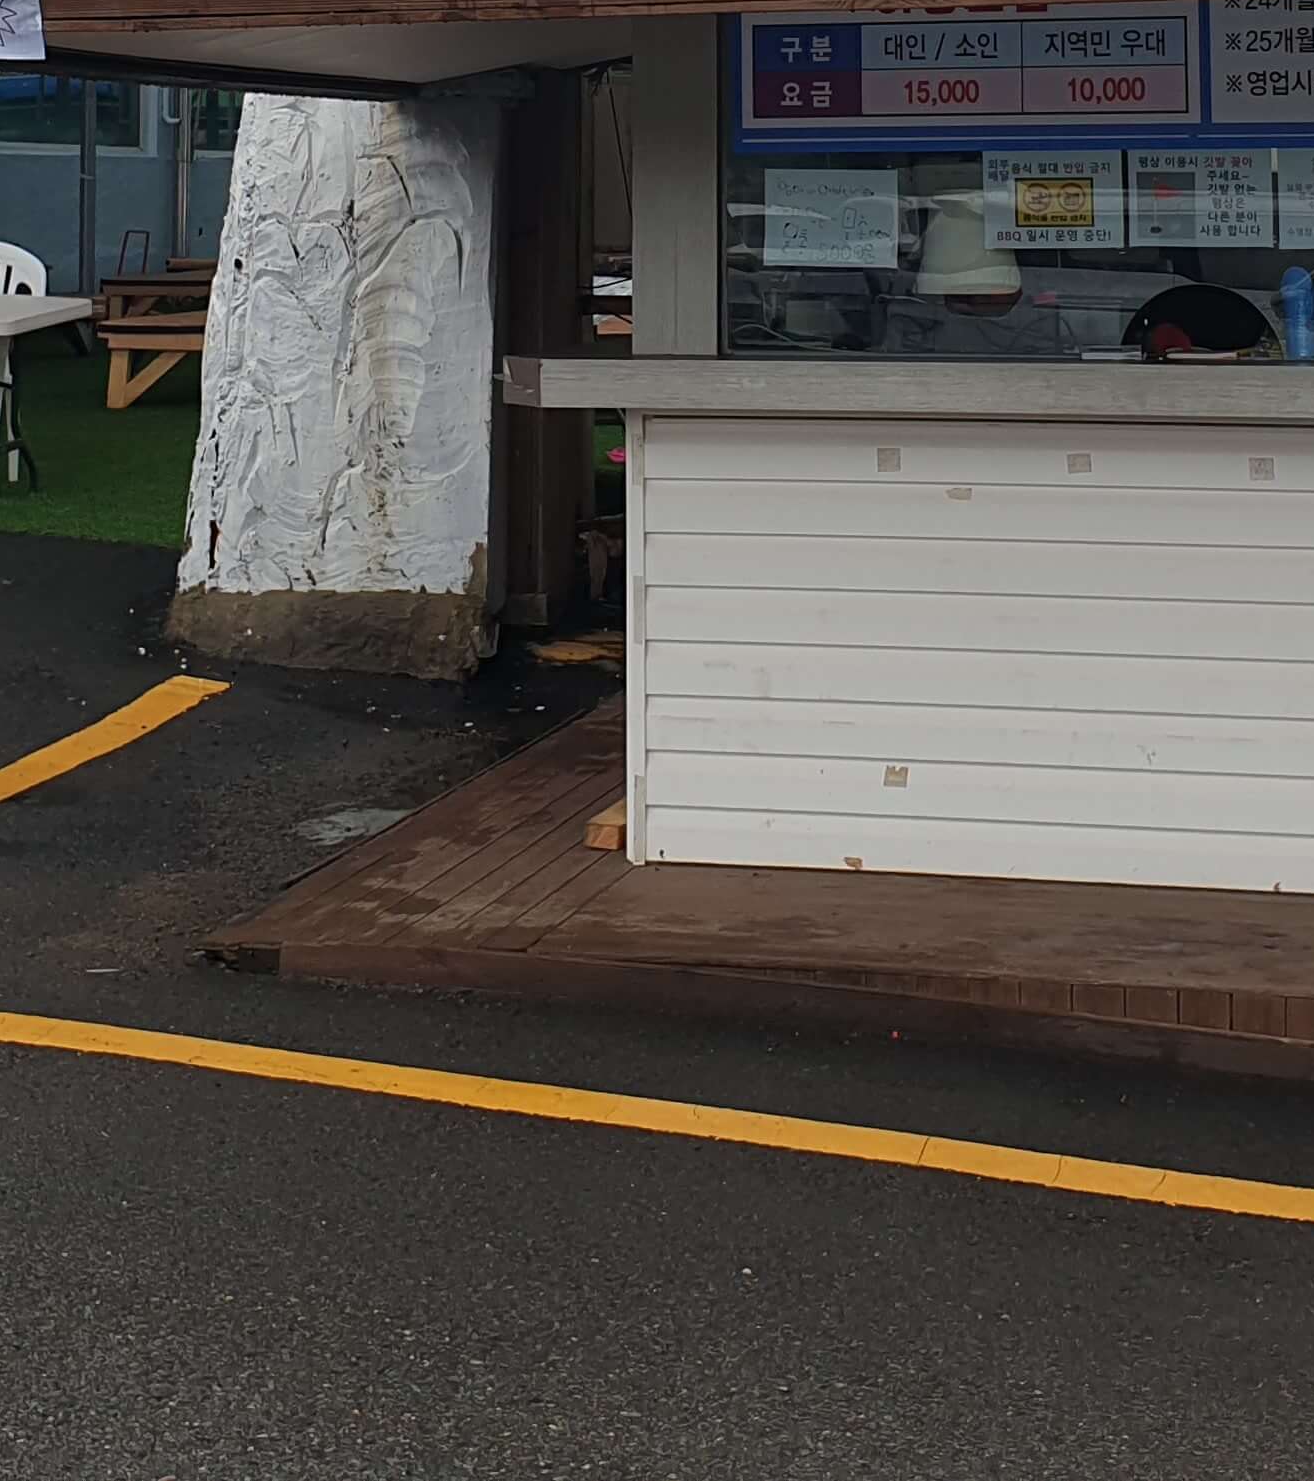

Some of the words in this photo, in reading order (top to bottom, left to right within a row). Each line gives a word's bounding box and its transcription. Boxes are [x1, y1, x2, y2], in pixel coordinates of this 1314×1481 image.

[780, 35, 833, 63] 구분
[884, 31, 927, 61] 대인
[955, 30, 999, 60] 소인
[1044, 28, 1111, 59] 지역민
[1120, 27, 1167, 57] 우대
[780, 81, 833, 108] 요금
[903, 78, 980, 106] 15,000
[1067, 76, 1146, 104] 10,000
[1063, 161, 1084, 174] 반입
[1089, 161, 1111, 174] 금지
[1165, 155, 1199, 168] 이용시
[1203, 156, 1226, 168] 깃발
[997, 231, 1022, 242] BBQ
[1027, 229, 1049, 242] 일시
[1228, 225, 1261, 237] 합니다
